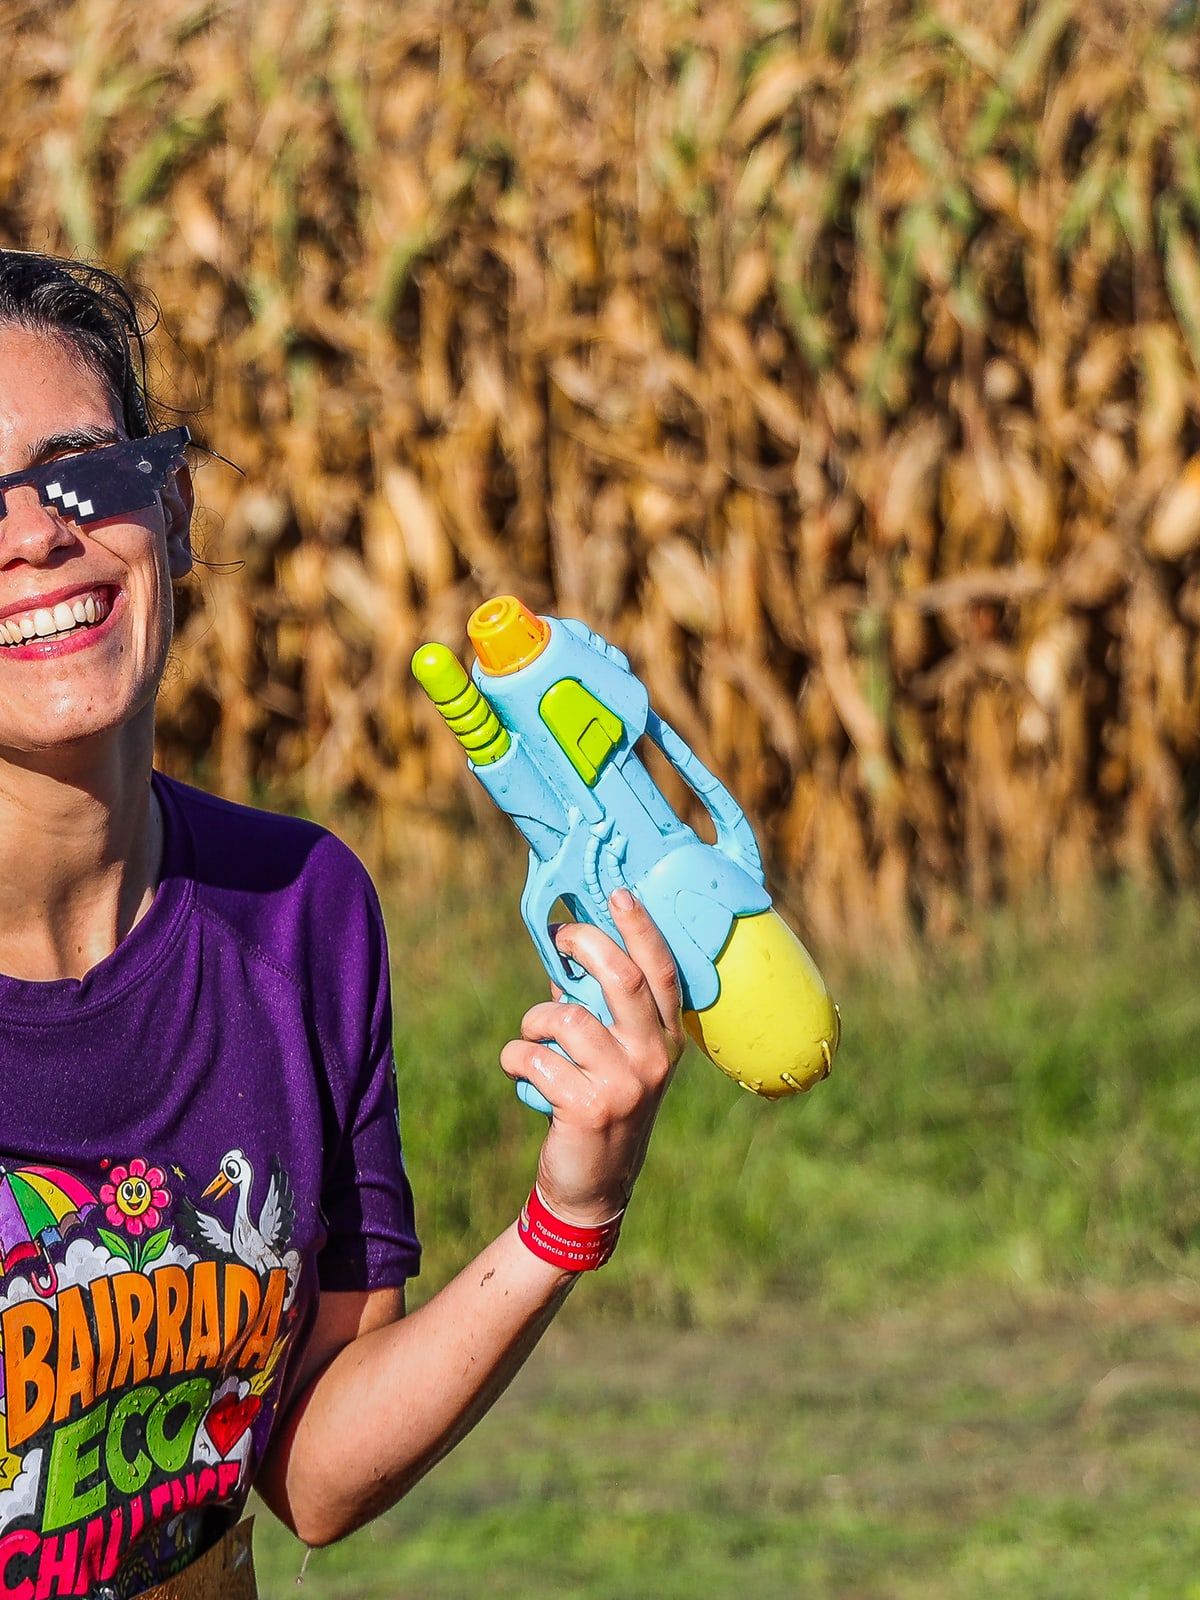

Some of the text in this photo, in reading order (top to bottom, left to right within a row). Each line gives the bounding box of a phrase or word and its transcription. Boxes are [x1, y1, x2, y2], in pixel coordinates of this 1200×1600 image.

[568, 1251, 584, 1260] 919
[0, 1260, 288, 1450] BAIRRADA
[42, 1376, 214, 1533] ECO
